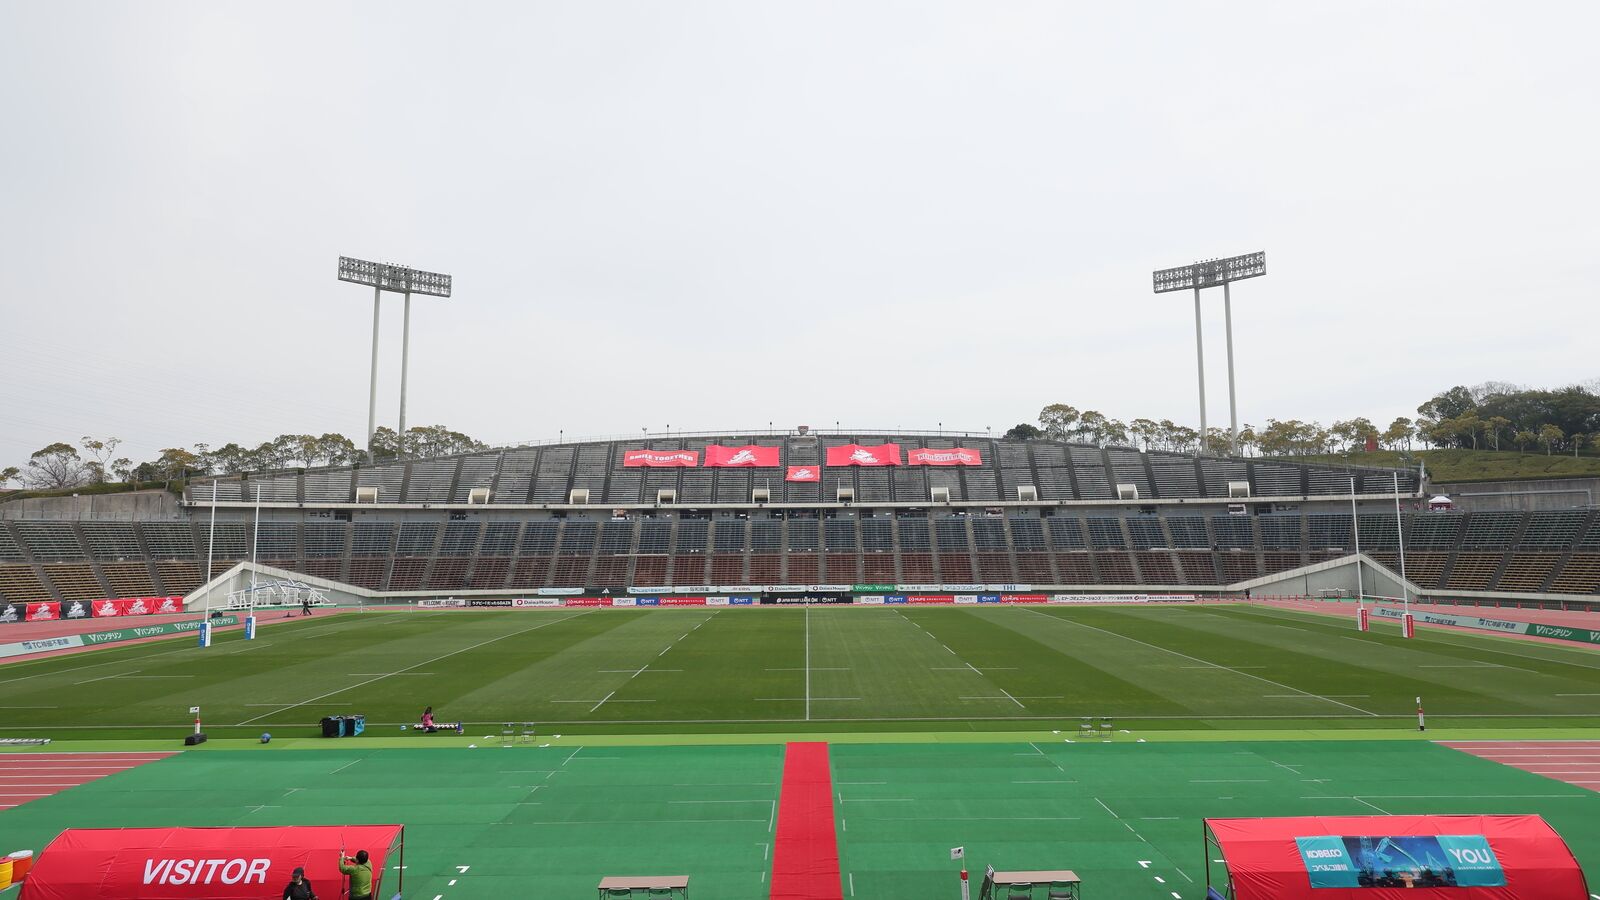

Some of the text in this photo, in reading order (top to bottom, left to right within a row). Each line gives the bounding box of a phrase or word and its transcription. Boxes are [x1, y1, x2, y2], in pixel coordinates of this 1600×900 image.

[1305, 848, 1343, 859] KOBELCO
[1448, 848, 1491, 864] YOU
[143, 858, 272, 885] VISITOR
